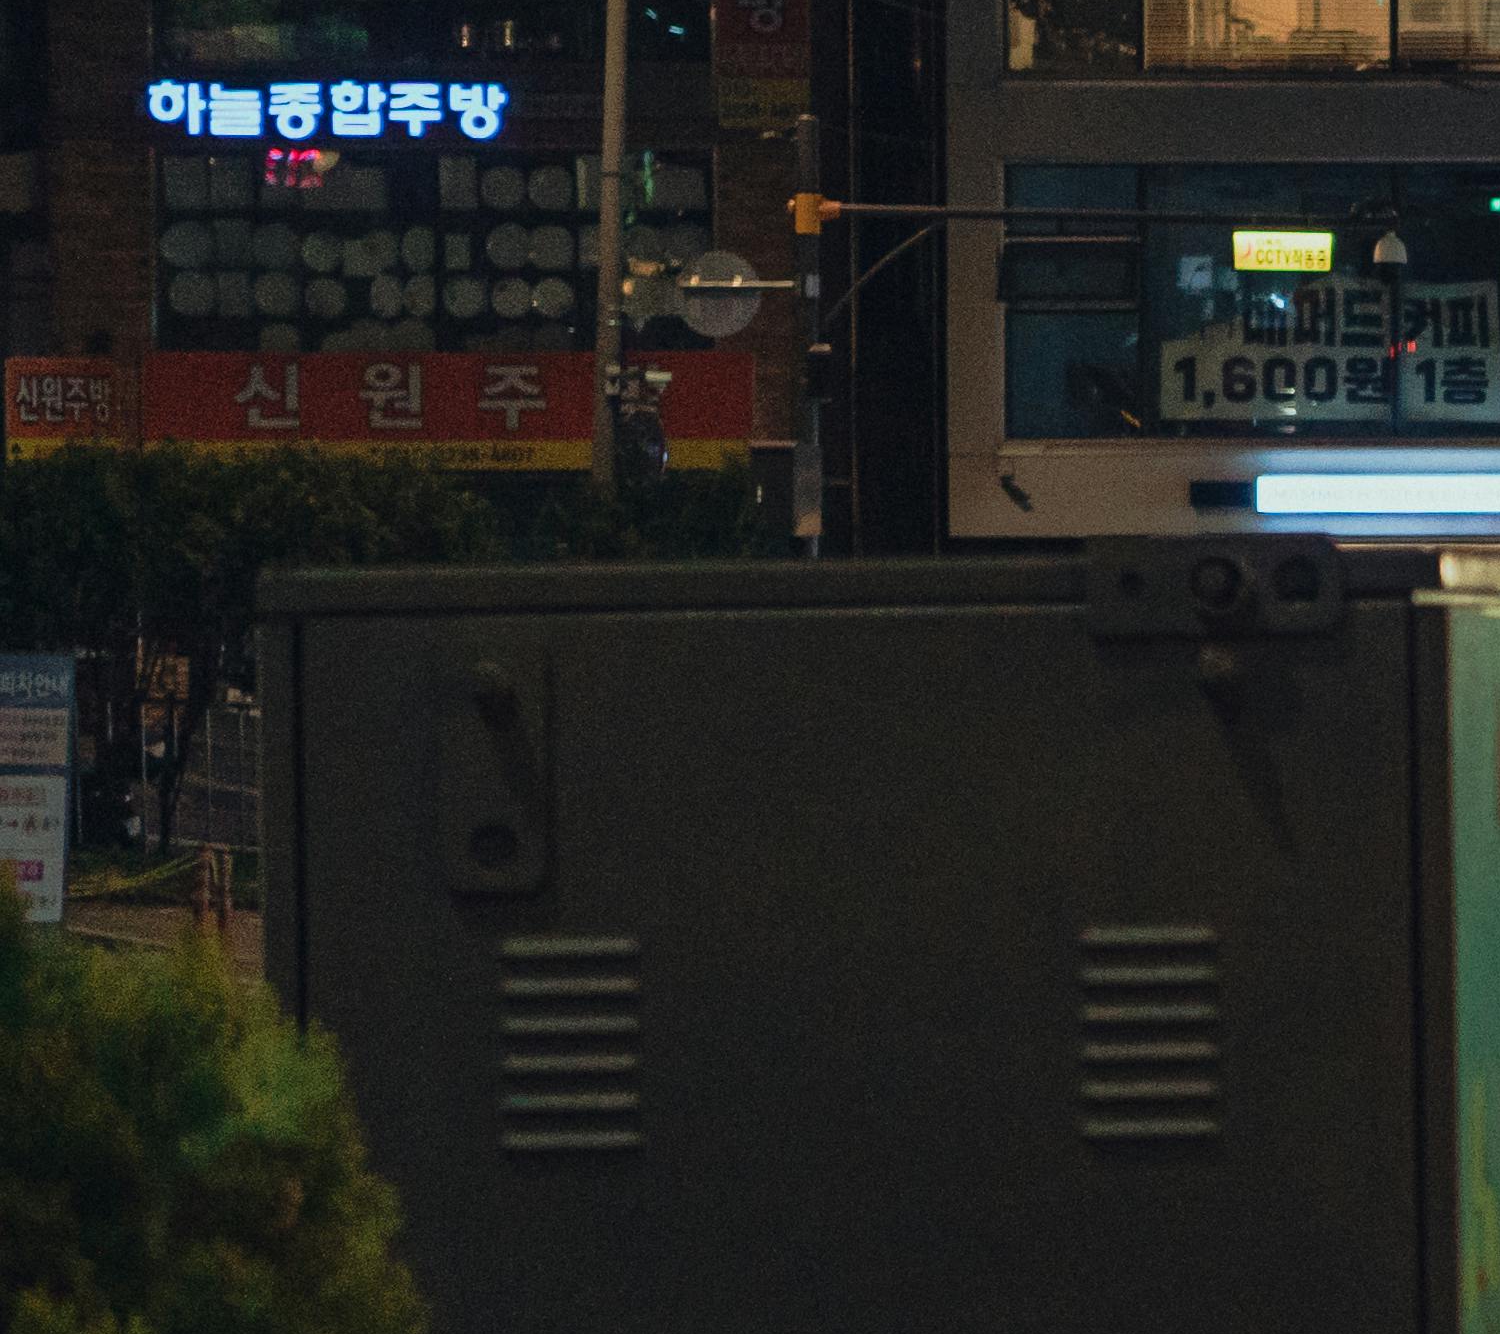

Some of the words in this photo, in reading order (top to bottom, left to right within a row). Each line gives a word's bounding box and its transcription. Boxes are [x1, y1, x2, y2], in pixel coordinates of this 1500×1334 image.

[145, 78, 511, 141] 하늘종합주방
[1174, 355, 1391, 408] 1,600원
[1415, 356, 1489, 404] 1층
